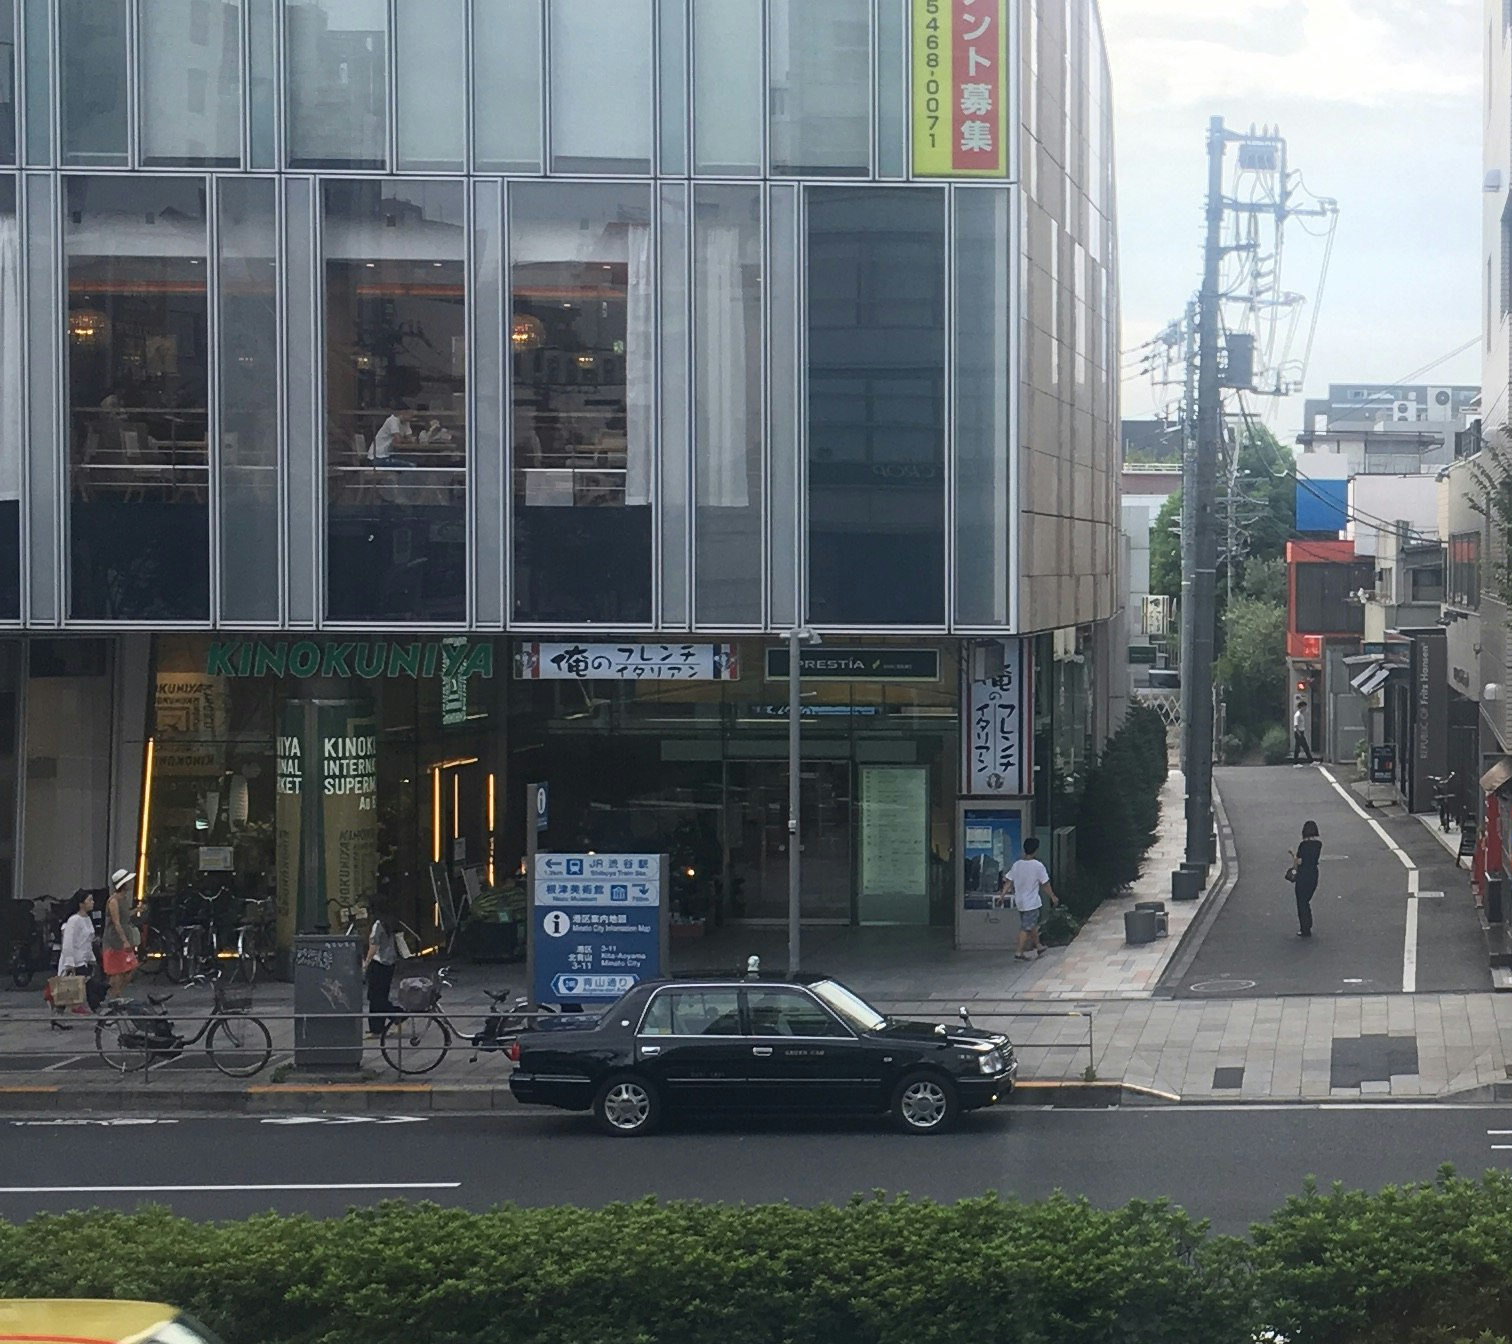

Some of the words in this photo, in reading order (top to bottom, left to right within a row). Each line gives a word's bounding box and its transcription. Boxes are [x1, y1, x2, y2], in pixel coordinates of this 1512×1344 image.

[206, 640, 493, 679] KINOKUNIYA
[550, 645, 612, 677] 俺の
[618, 646, 696, 661] フレンチ
[616, 665, 699, 678] イタリアン
[975, 703, 991, 773] イタリアン
[998, 704, 1016, 772] フレンチ
